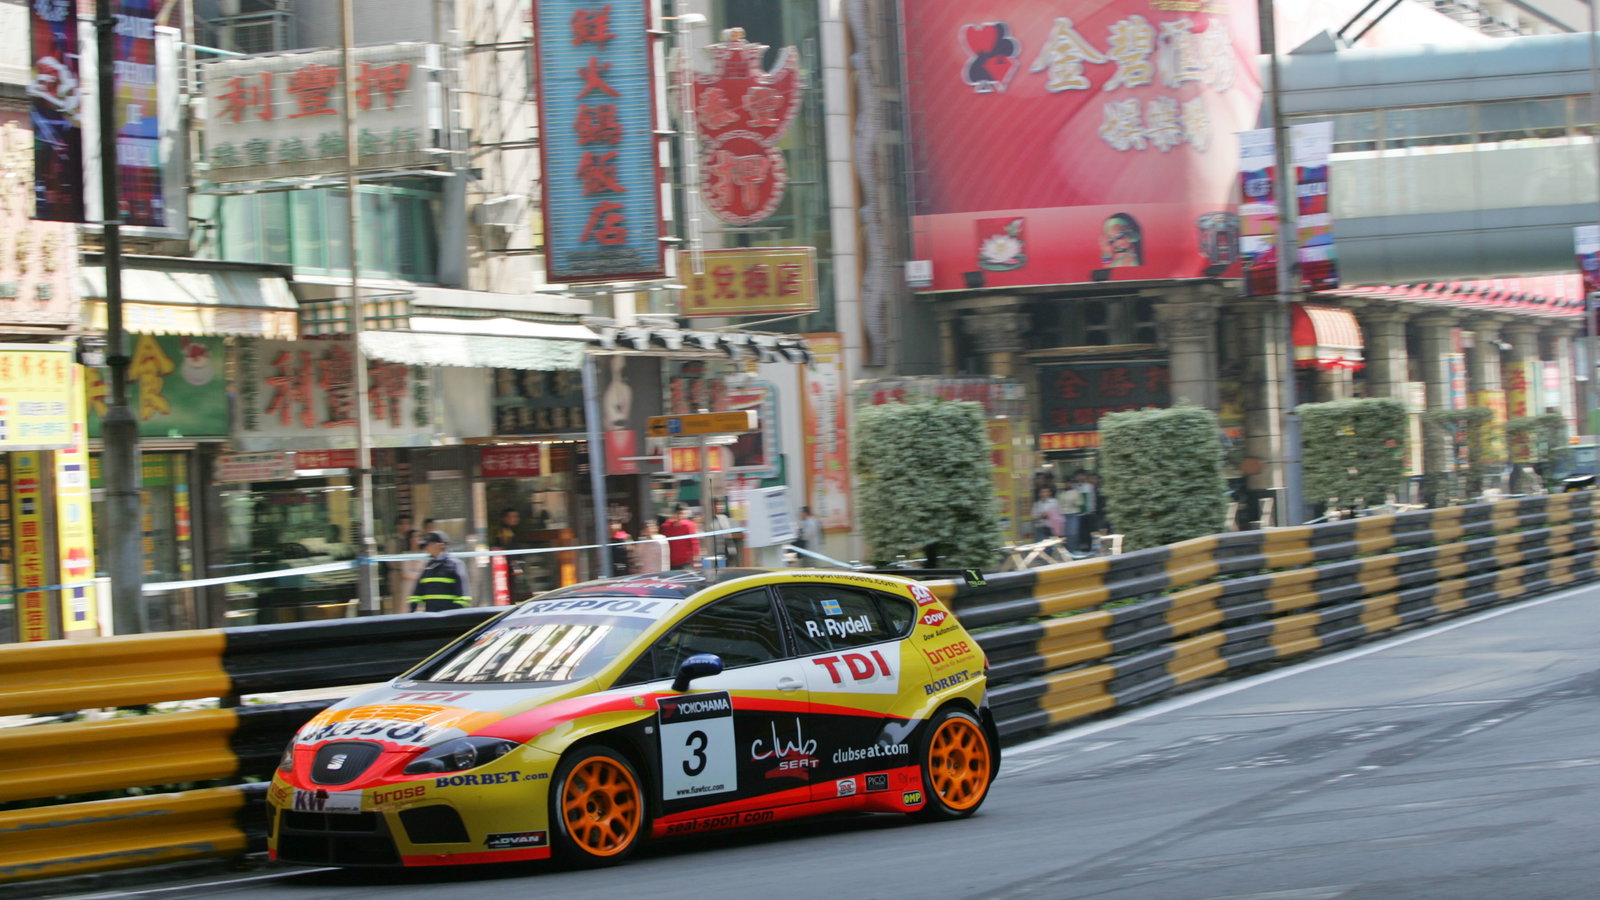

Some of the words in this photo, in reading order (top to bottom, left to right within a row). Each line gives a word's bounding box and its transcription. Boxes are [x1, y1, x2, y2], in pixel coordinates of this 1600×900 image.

[521, 600, 660, 615] REPSOL
[806, 620, 824, 638] R.
[824, 615, 872, 639] Rydell
[923, 641, 972, 665] brose
[812, 650, 892, 684] TDI
[391, 692, 473, 702] TDI
[678, 699, 730, 715] YOKOHAMA
[751, 717, 817, 760] club
[682, 730, 708, 777] 3
[832, 742, 909, 764] clubseat.com
[779, 759, 820, 771] SEAT
[374, 786, 426, 805] brose
[903, 793, 921, 803] OMP
